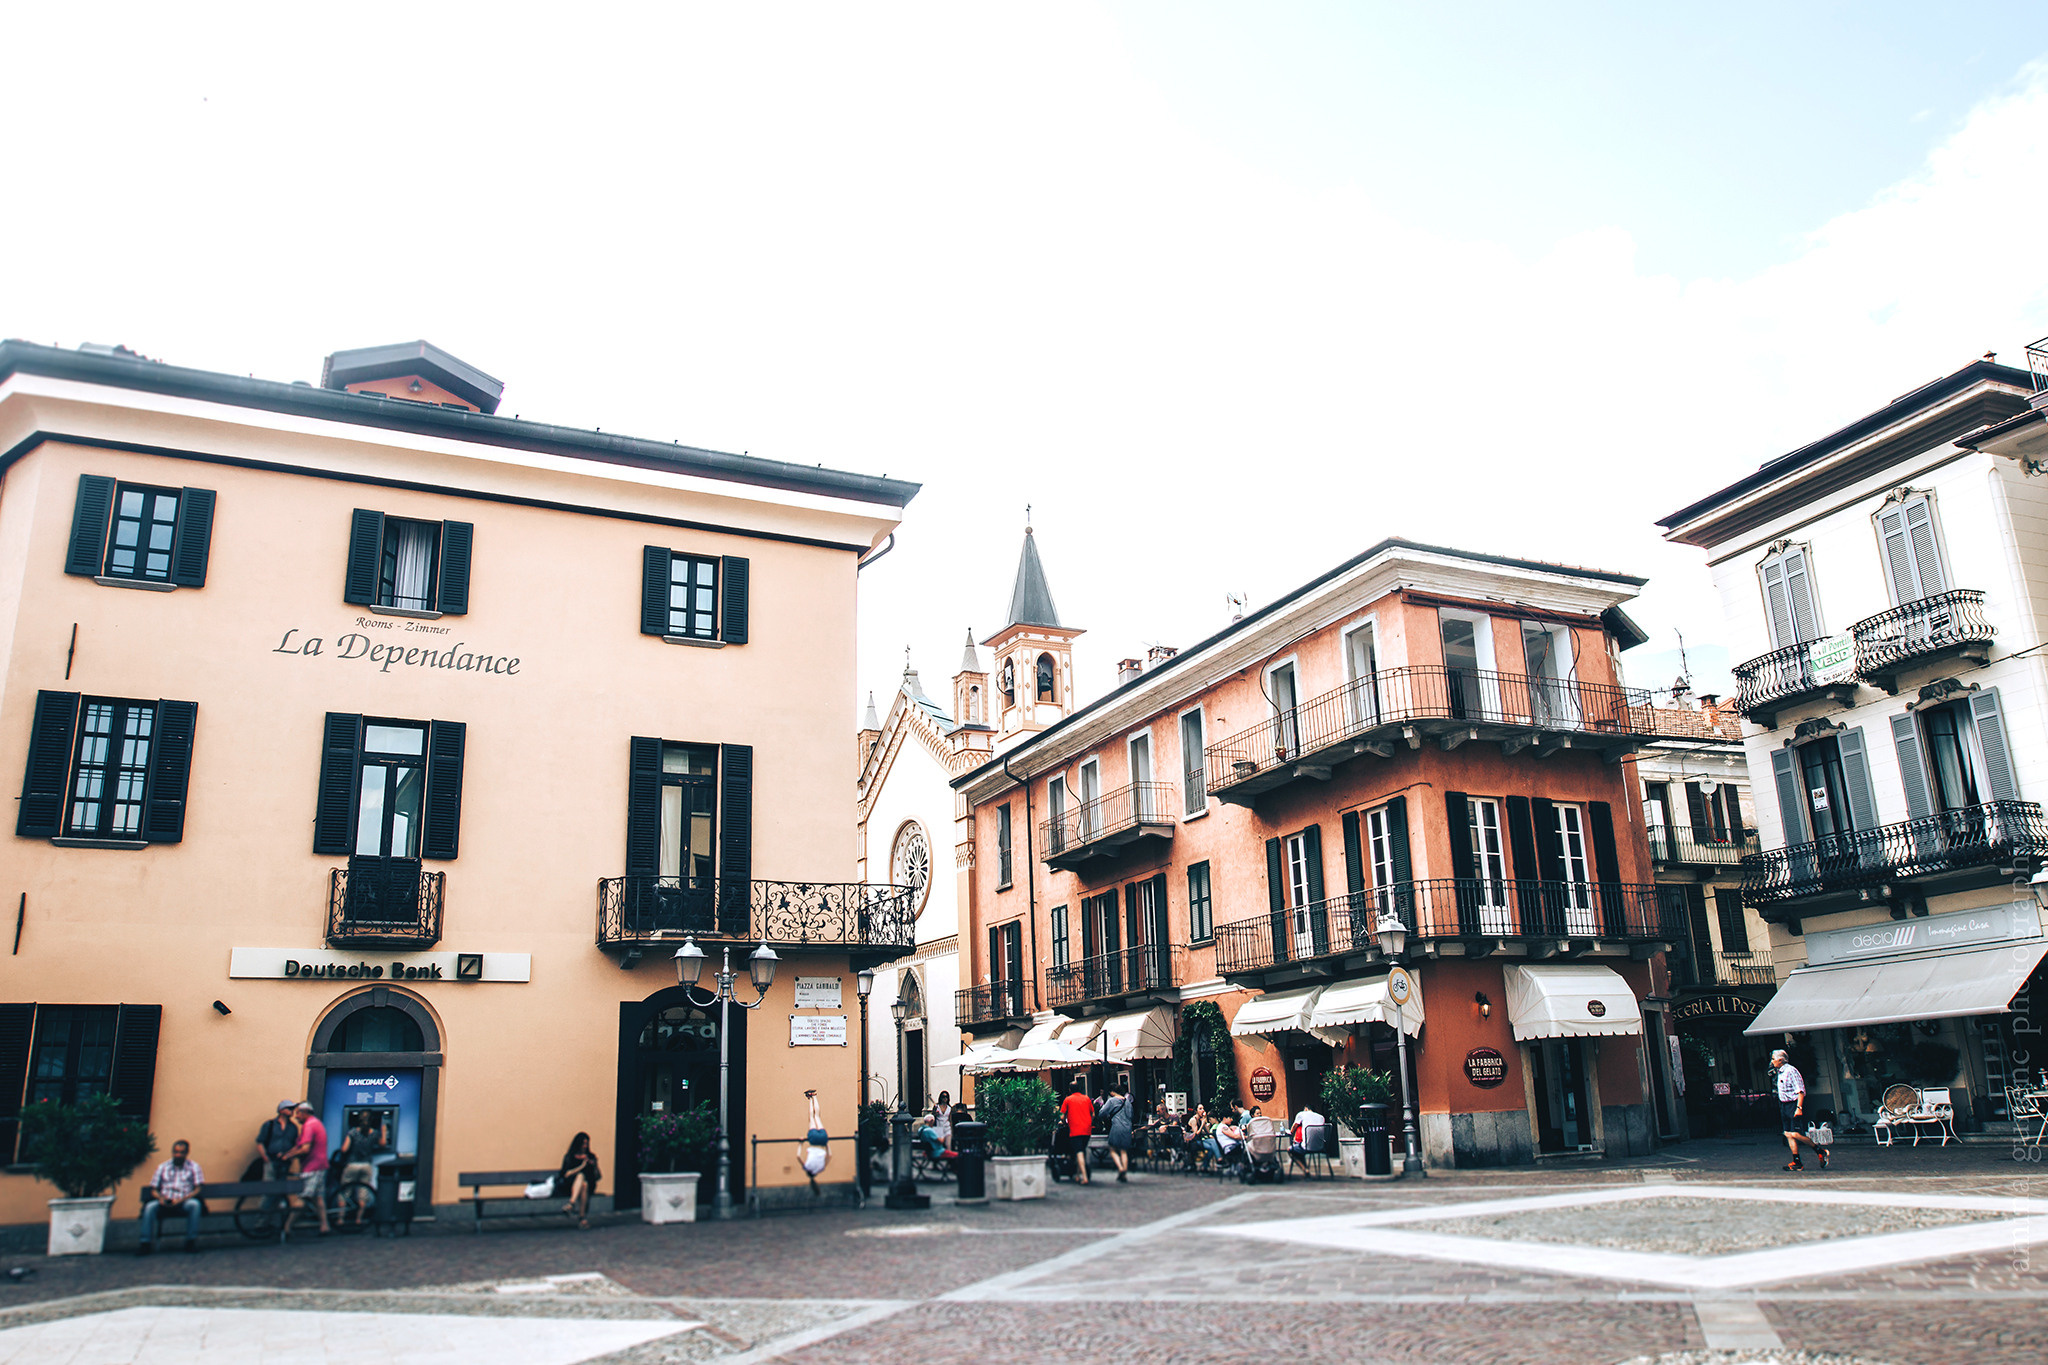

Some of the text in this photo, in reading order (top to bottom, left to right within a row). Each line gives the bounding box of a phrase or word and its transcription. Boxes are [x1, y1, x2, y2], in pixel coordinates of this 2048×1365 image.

[356, 616, 393, 630] Rooms
[404, 621, 451, 635] Zimmer
[272, 628, 521, 675] La Dependance
[1928, 919, 1990, 938] Immagine Casa
[1852, 931, 1894, 948] decio
[285, 960, 443, 979] Deutsche Bank
[1468, 1057, 1503, 1067] LA FABBRICA
[1471, 1067, 1502, 1077] DEL GELATO
[348, 1078, 384, 1086] BANCOMAT
